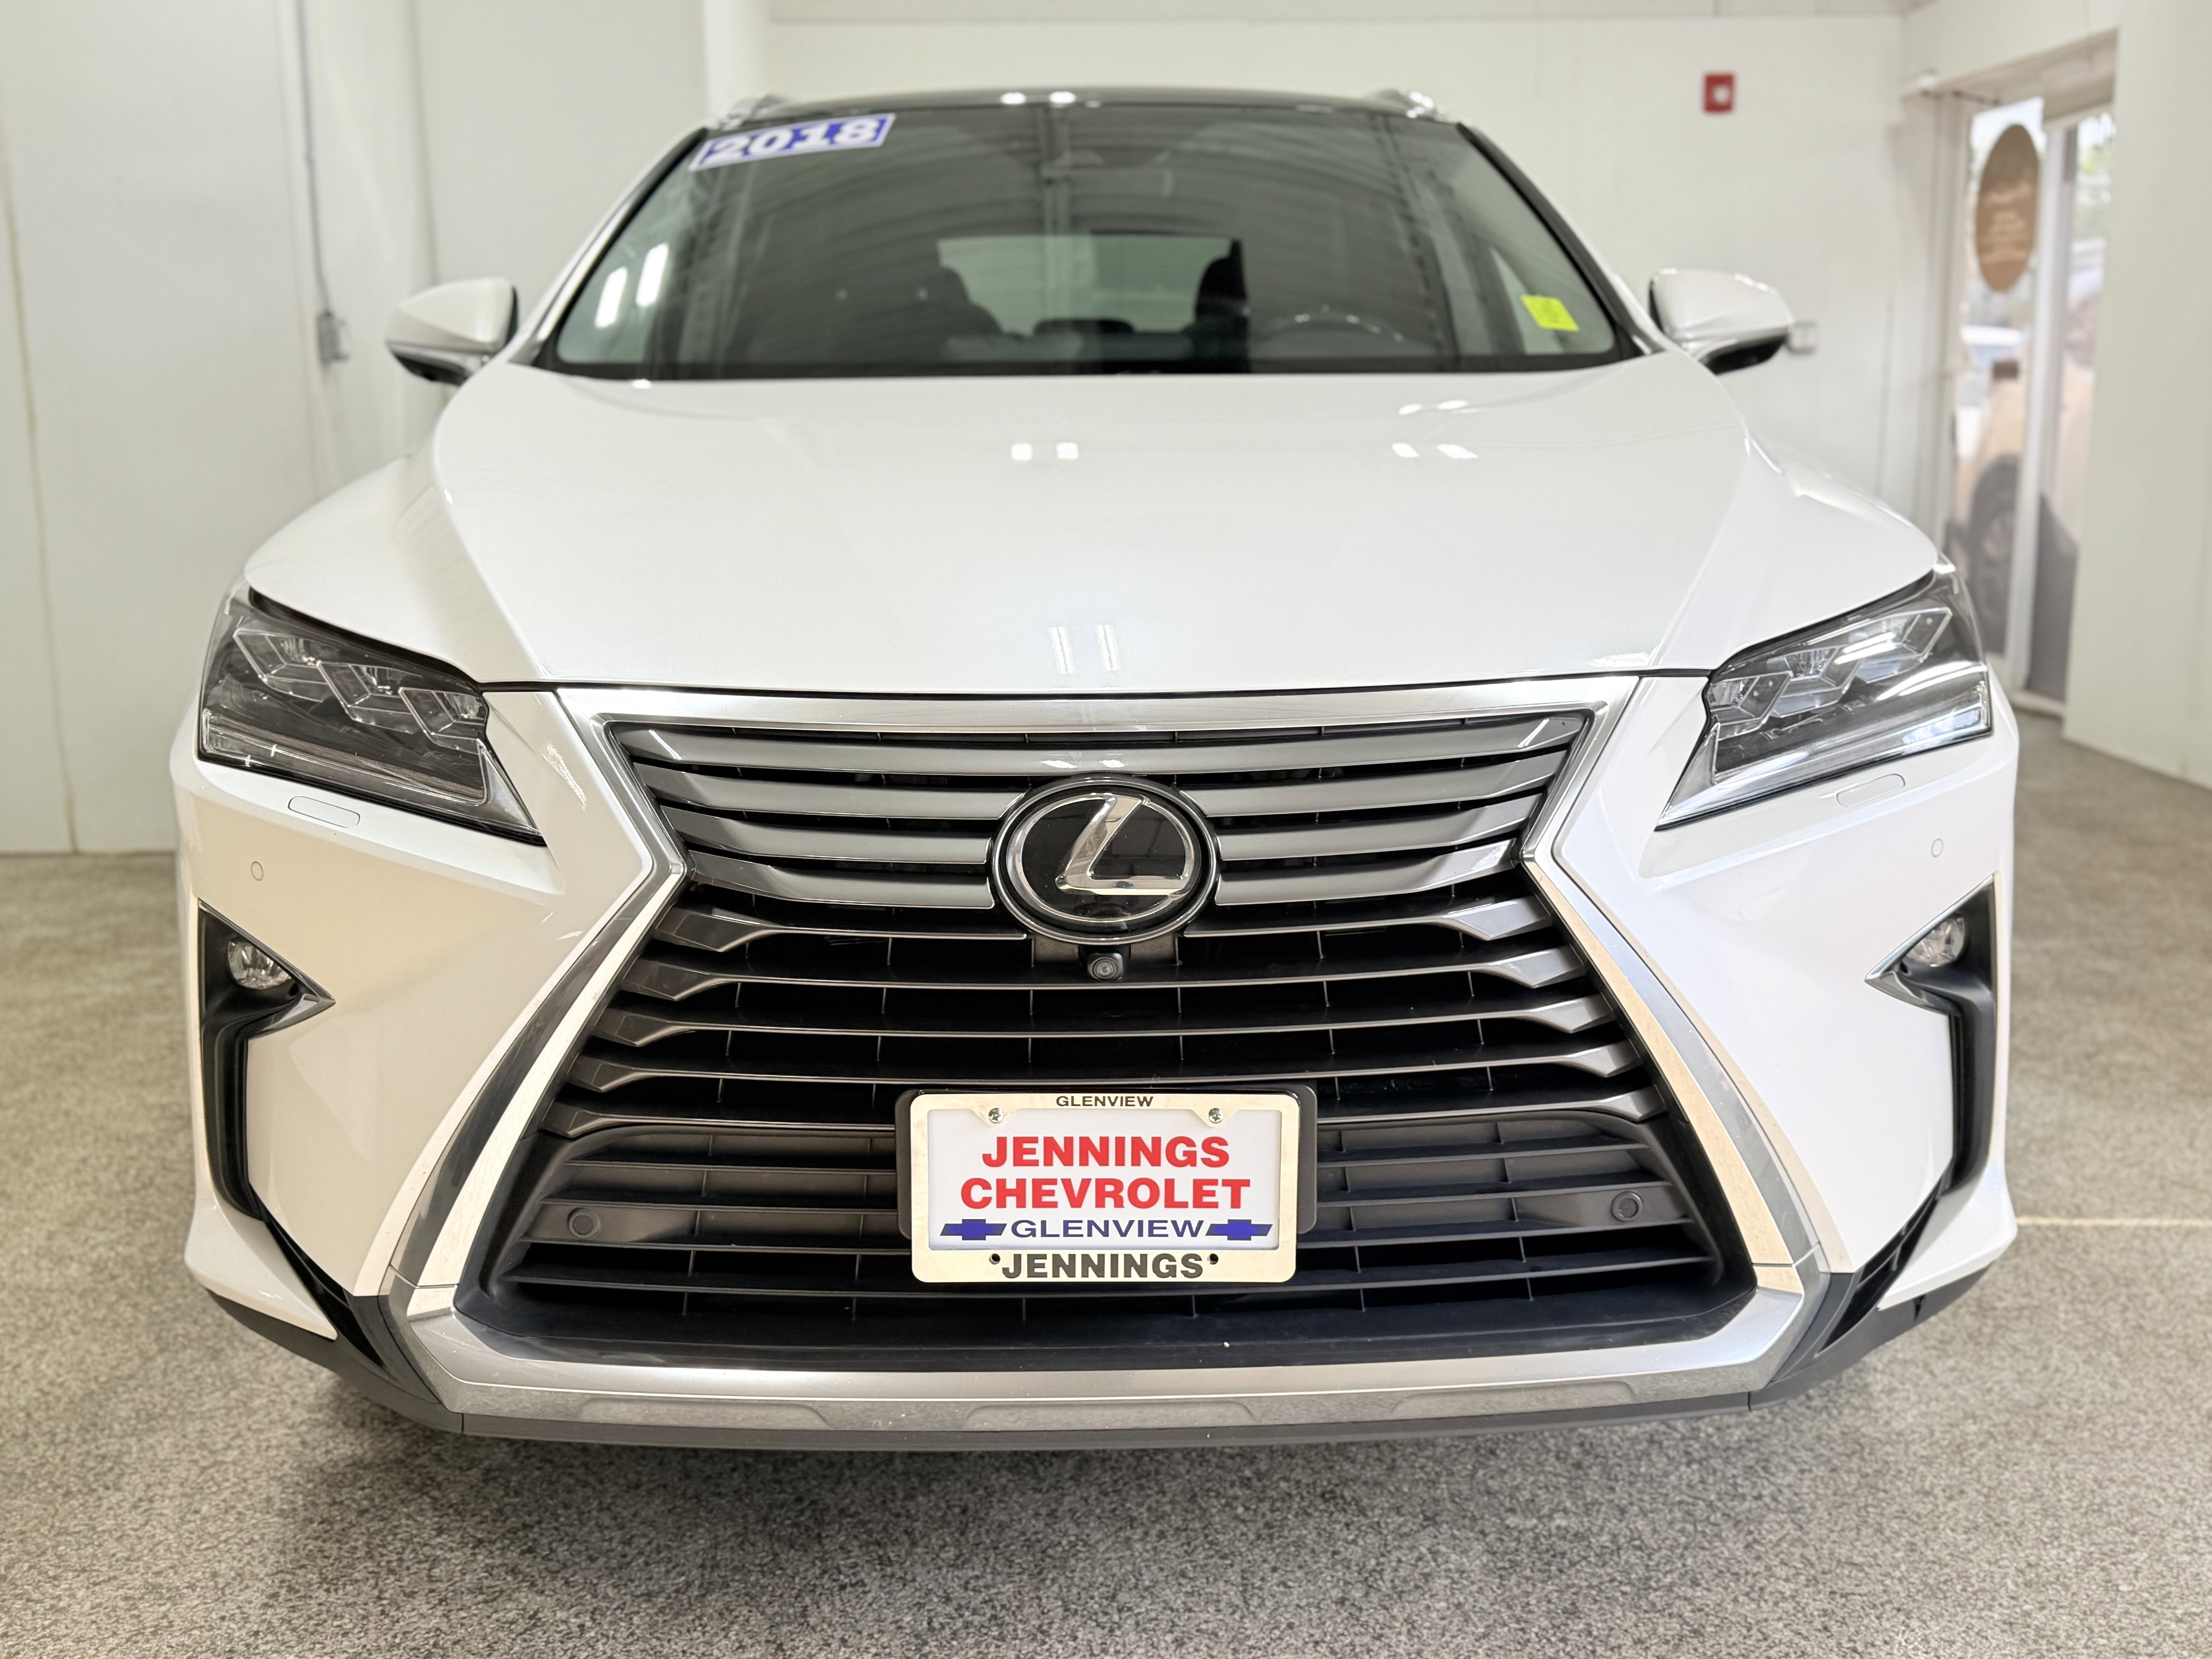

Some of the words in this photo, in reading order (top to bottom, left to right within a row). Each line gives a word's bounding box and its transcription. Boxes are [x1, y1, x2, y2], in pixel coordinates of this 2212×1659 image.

[699, 118, 879, 164] 2018
[1056, 1096, 1153, 1107] GLENVIEW
[982, 1136, 1229, 1167] JENNINGS
[961, 1178, 1250, 1208] CHEVROLET
[1011, 1220, 1204, 1237] GLENVIEW
[1003, 1254, 1203, 1279] JENNINGS
